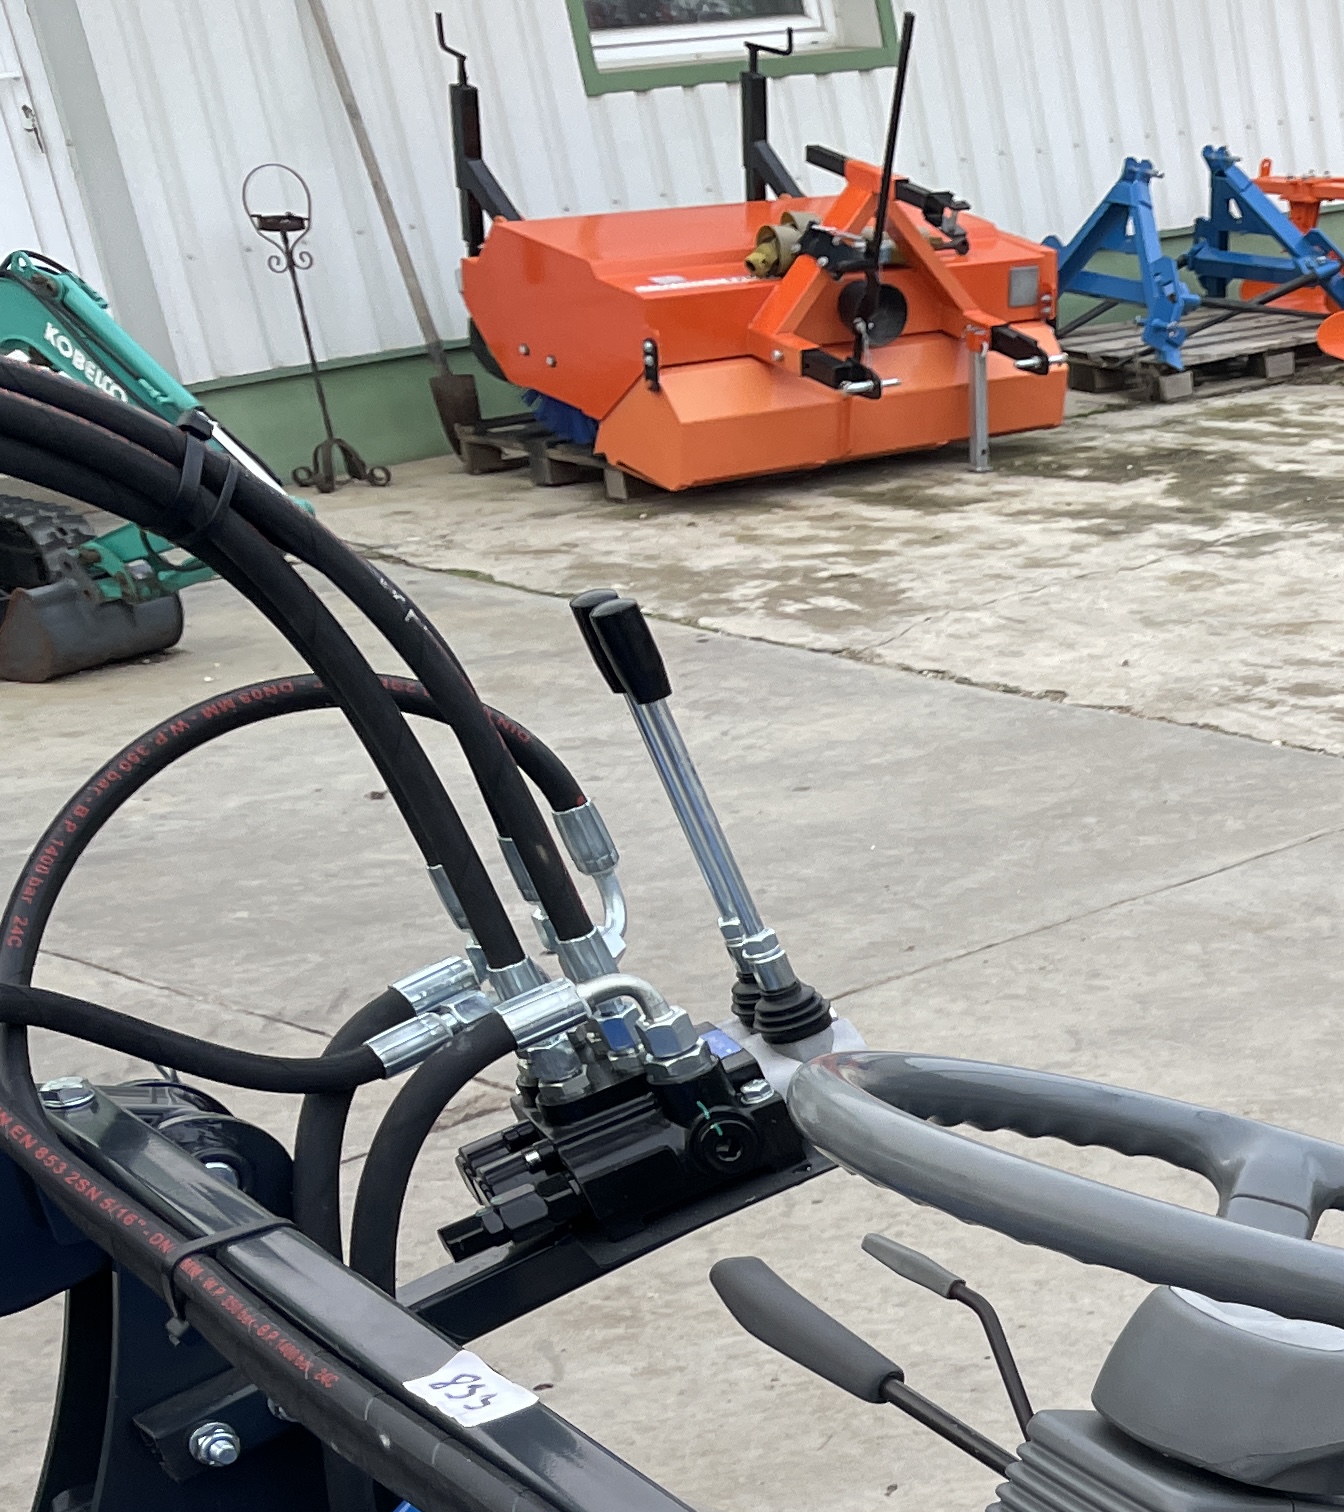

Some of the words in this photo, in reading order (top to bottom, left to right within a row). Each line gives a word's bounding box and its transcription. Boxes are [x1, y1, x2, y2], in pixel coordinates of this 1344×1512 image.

[21, 877, 44, 905] bar
[7, 915, 29, 948] 24C
[10, 1124, 37, 1149] EN
[34, 1146, 68, 1175] 853
[64, 1171, 103, 1202] 2SN
